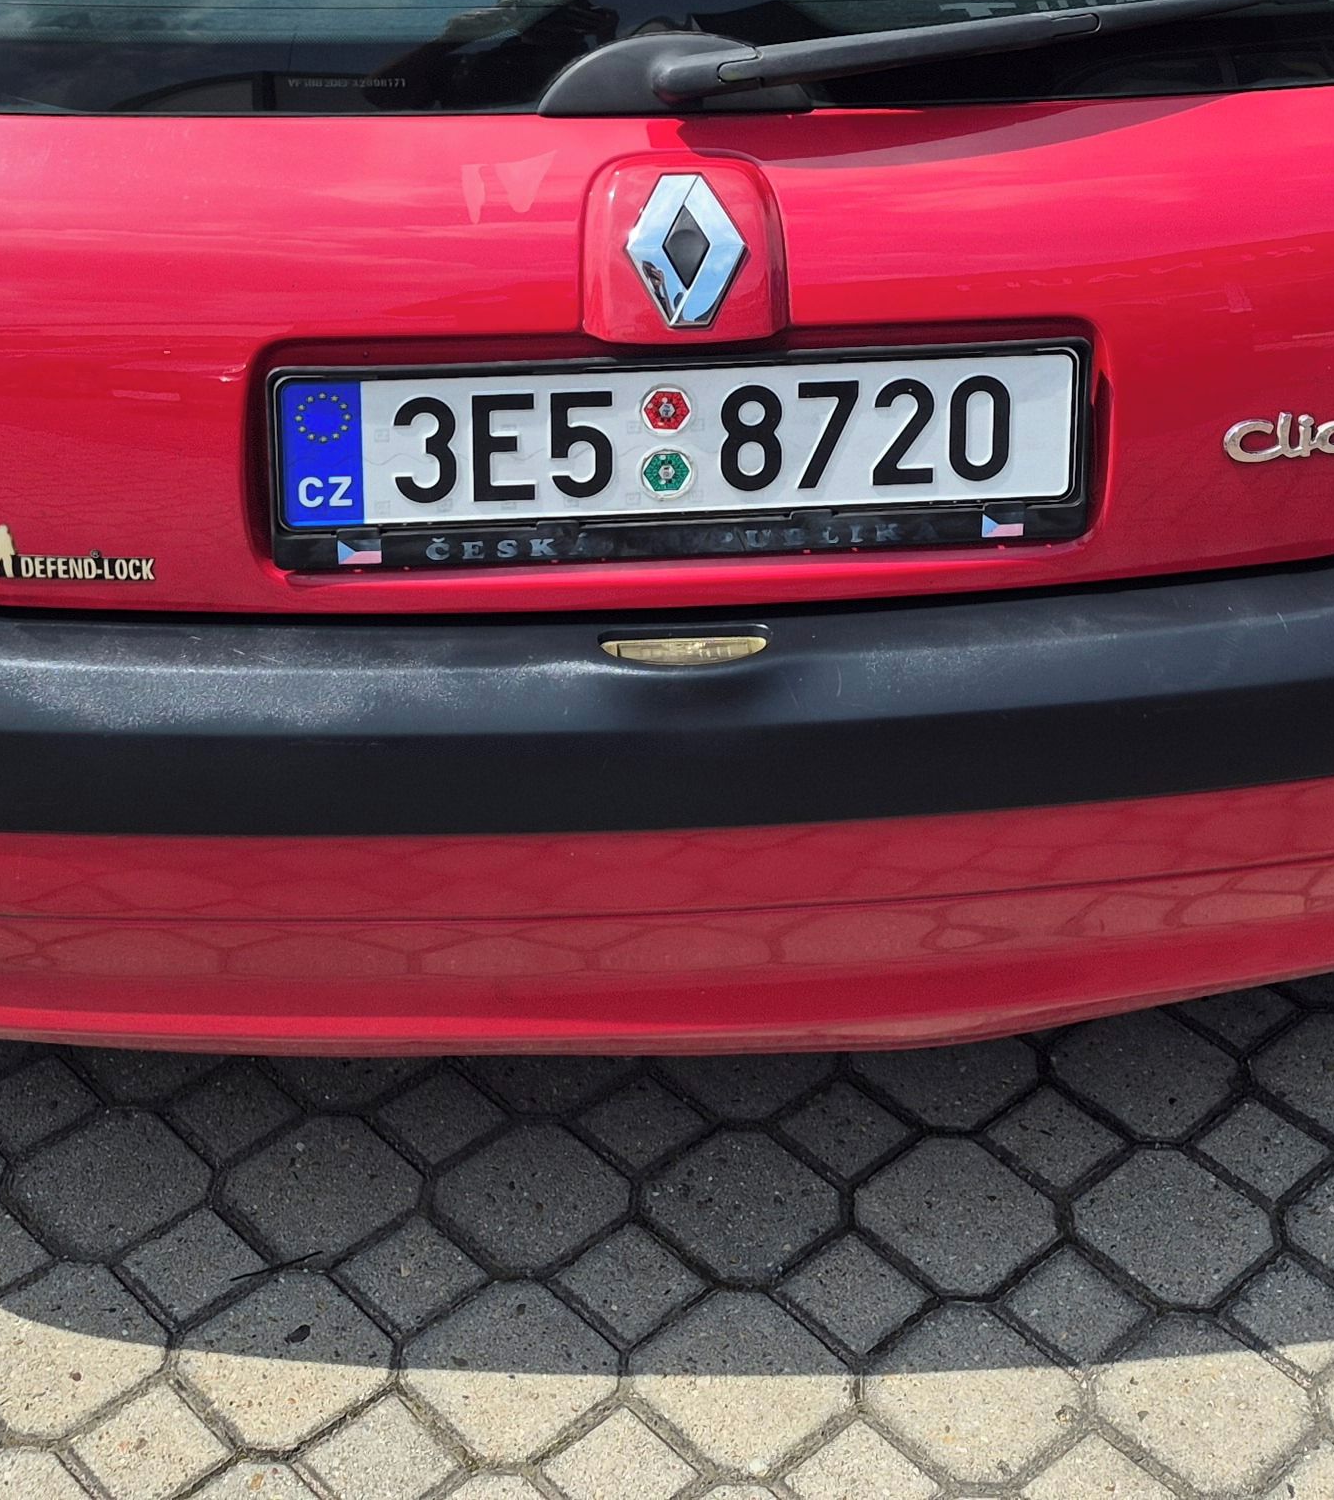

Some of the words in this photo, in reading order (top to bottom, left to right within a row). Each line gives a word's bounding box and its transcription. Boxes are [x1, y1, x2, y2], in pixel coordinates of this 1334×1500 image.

[298, 476, 353, 508] CZ
[393, 390, 613, 504] 3E5
[720, 374, 1011, 492] 8720
[20, 556, 155, 580] DEFEND-LOCK
